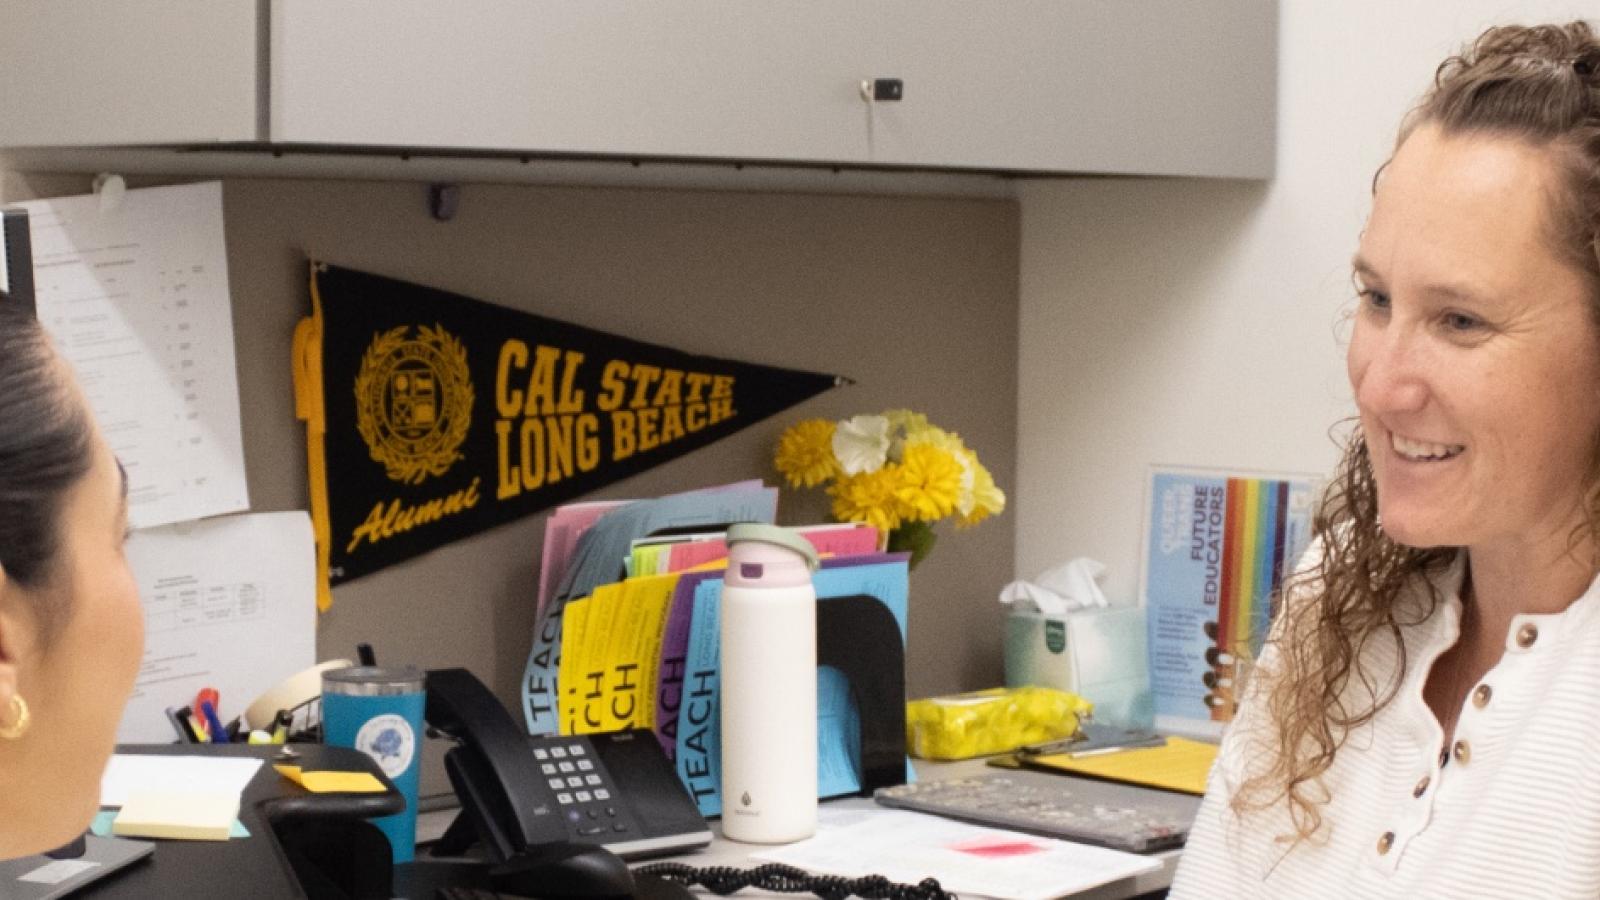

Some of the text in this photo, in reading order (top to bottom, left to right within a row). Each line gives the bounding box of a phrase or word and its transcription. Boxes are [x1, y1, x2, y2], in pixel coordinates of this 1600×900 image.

[496, 339, 585, 419] CAL
[597, 360, 736, 411] STATE
[495, 399, 733, 500] LONG BEACH
[346, 476, 481, 553] Alumni
[1191, 484, 1208, 562] FUTURE
[1203, 486, 1224, 606] EDUCATORS
[685, 669, 716, 806] TEACH
